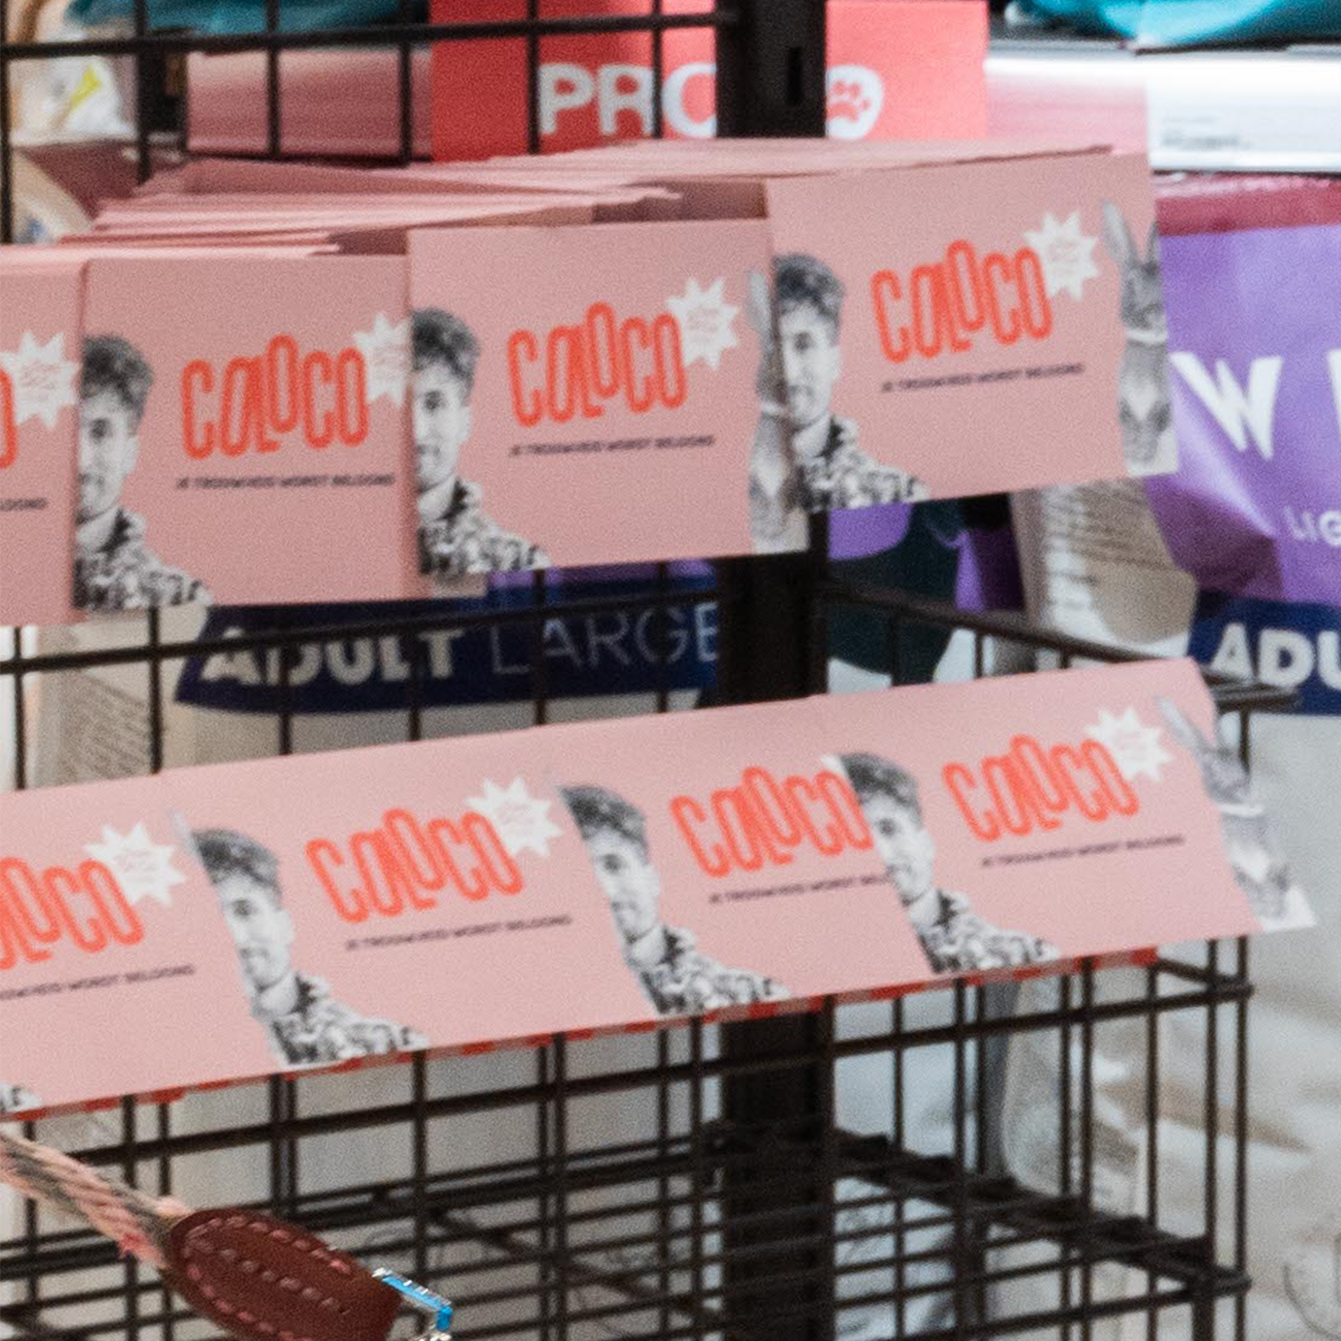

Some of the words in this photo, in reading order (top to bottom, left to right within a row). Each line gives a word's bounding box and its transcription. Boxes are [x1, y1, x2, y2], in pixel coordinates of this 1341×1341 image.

[870, 238, 1053, 363] COLOCO
[181, 333, 369, 460] COLOCO
[506, 301, 688, 428] COLOCO
[669, 765, 873, 878] COLOCO
[940, 733, 1142, 842] COLOCO
[304, 807, 525, 923] COLOCO
